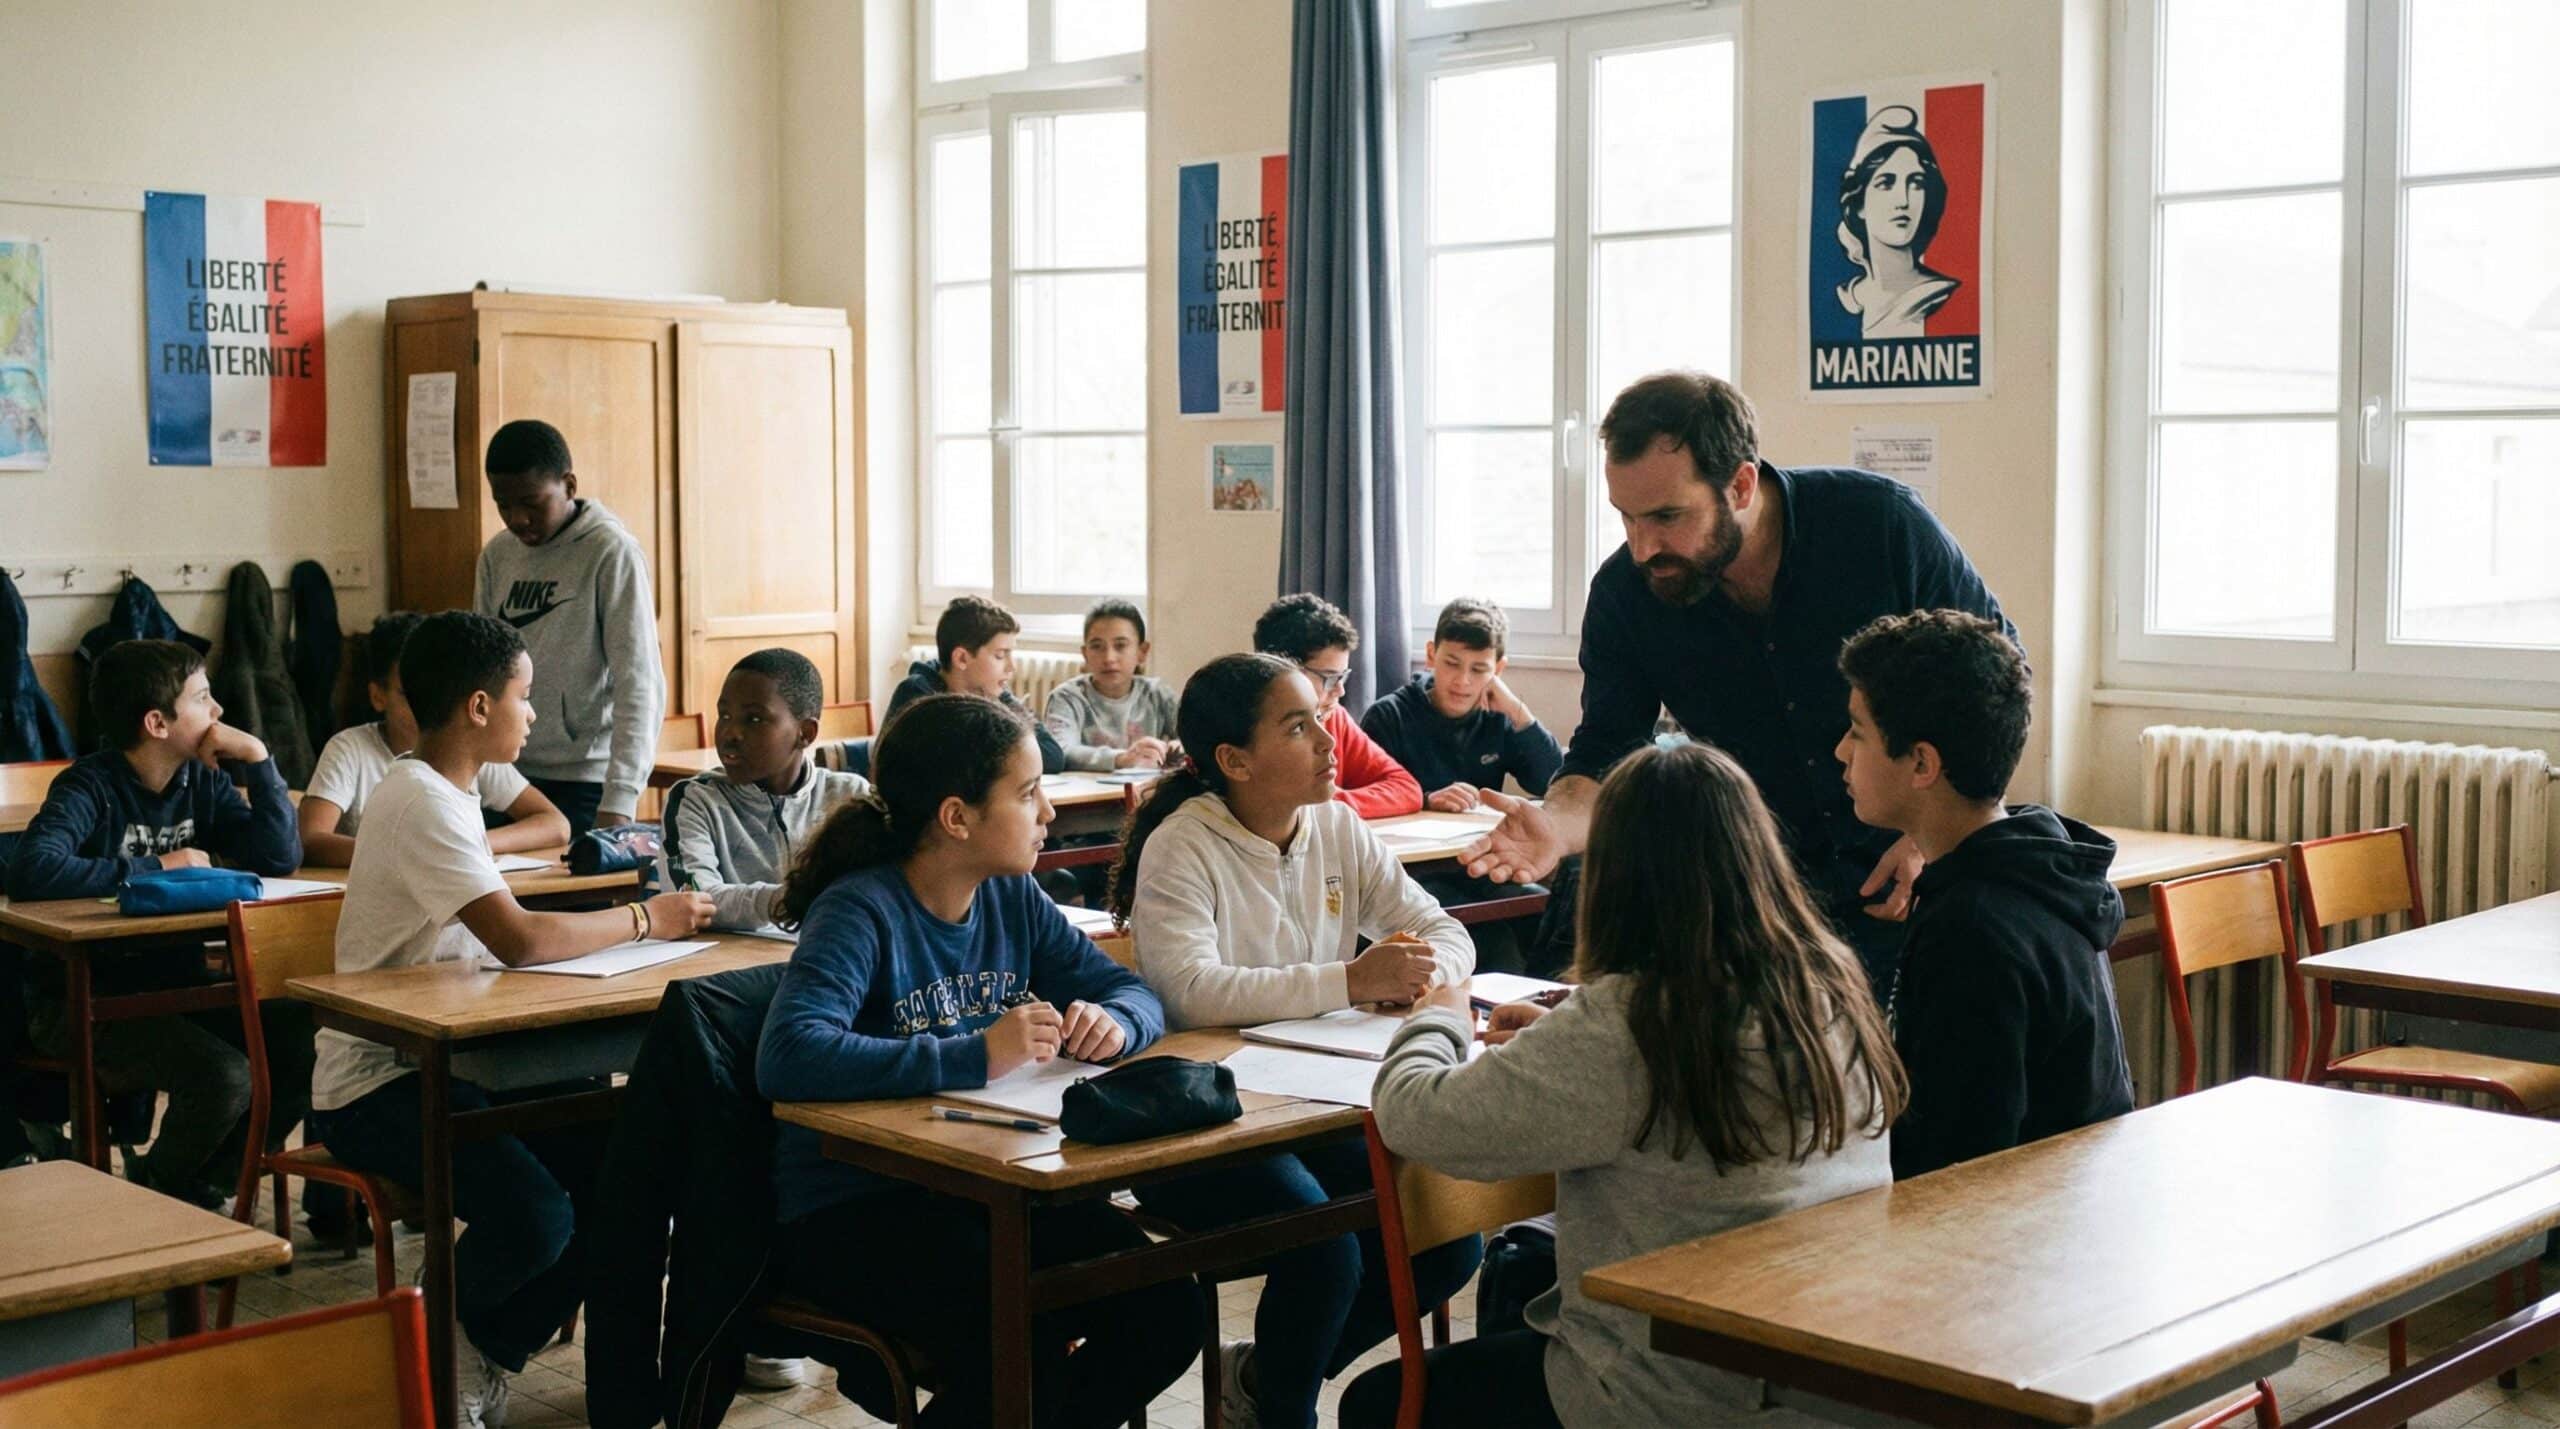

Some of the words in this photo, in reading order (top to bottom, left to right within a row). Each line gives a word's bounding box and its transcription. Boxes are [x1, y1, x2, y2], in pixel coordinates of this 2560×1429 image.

[186, 256, 287, 293] LIBERTÉ
[1204, 251, 1277, 292] ÉGALITÉ
[187, 295, 288, 334] ÉGALITÉ
[1186, 300, 1285, 334] FRATERNIT
[162, 342, 313, 378] FRATERNITÉ
[1816, 342, 1974, 384] MARIANNE
[505, 580, 559, 609] NIKE
